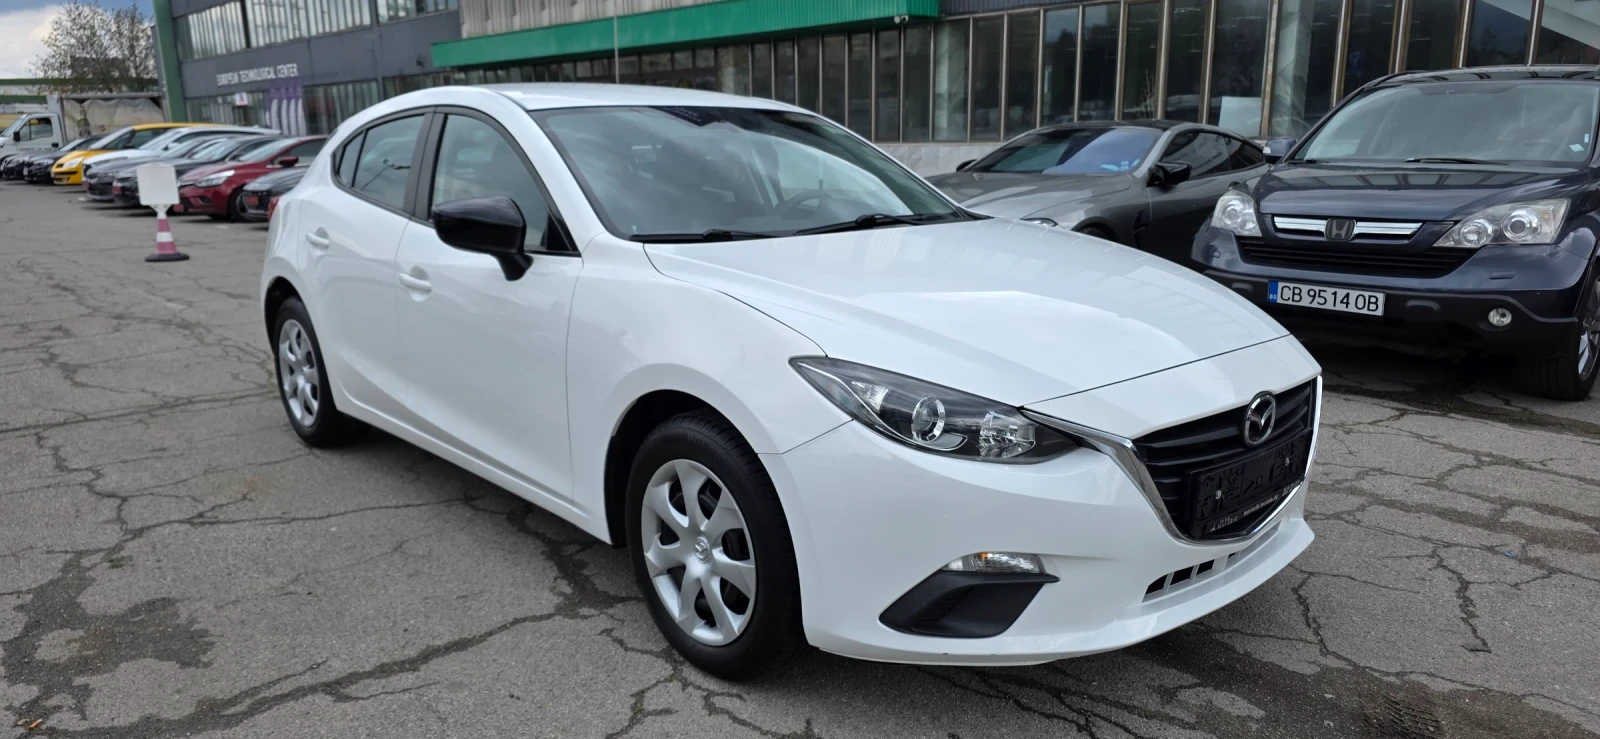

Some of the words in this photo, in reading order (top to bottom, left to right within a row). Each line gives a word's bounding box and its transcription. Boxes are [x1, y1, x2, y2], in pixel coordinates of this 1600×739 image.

[216, 72, 239, 86] EUROPEAN
[239, 67, 276, 82] TECHNOLOGICAL
[276, 63, 299, 78] CENTER
[1280, 285, 1303, 303] CB
[1307, 288, 1350, 309] 9514
[1354, 293, 1379, 312] OB
